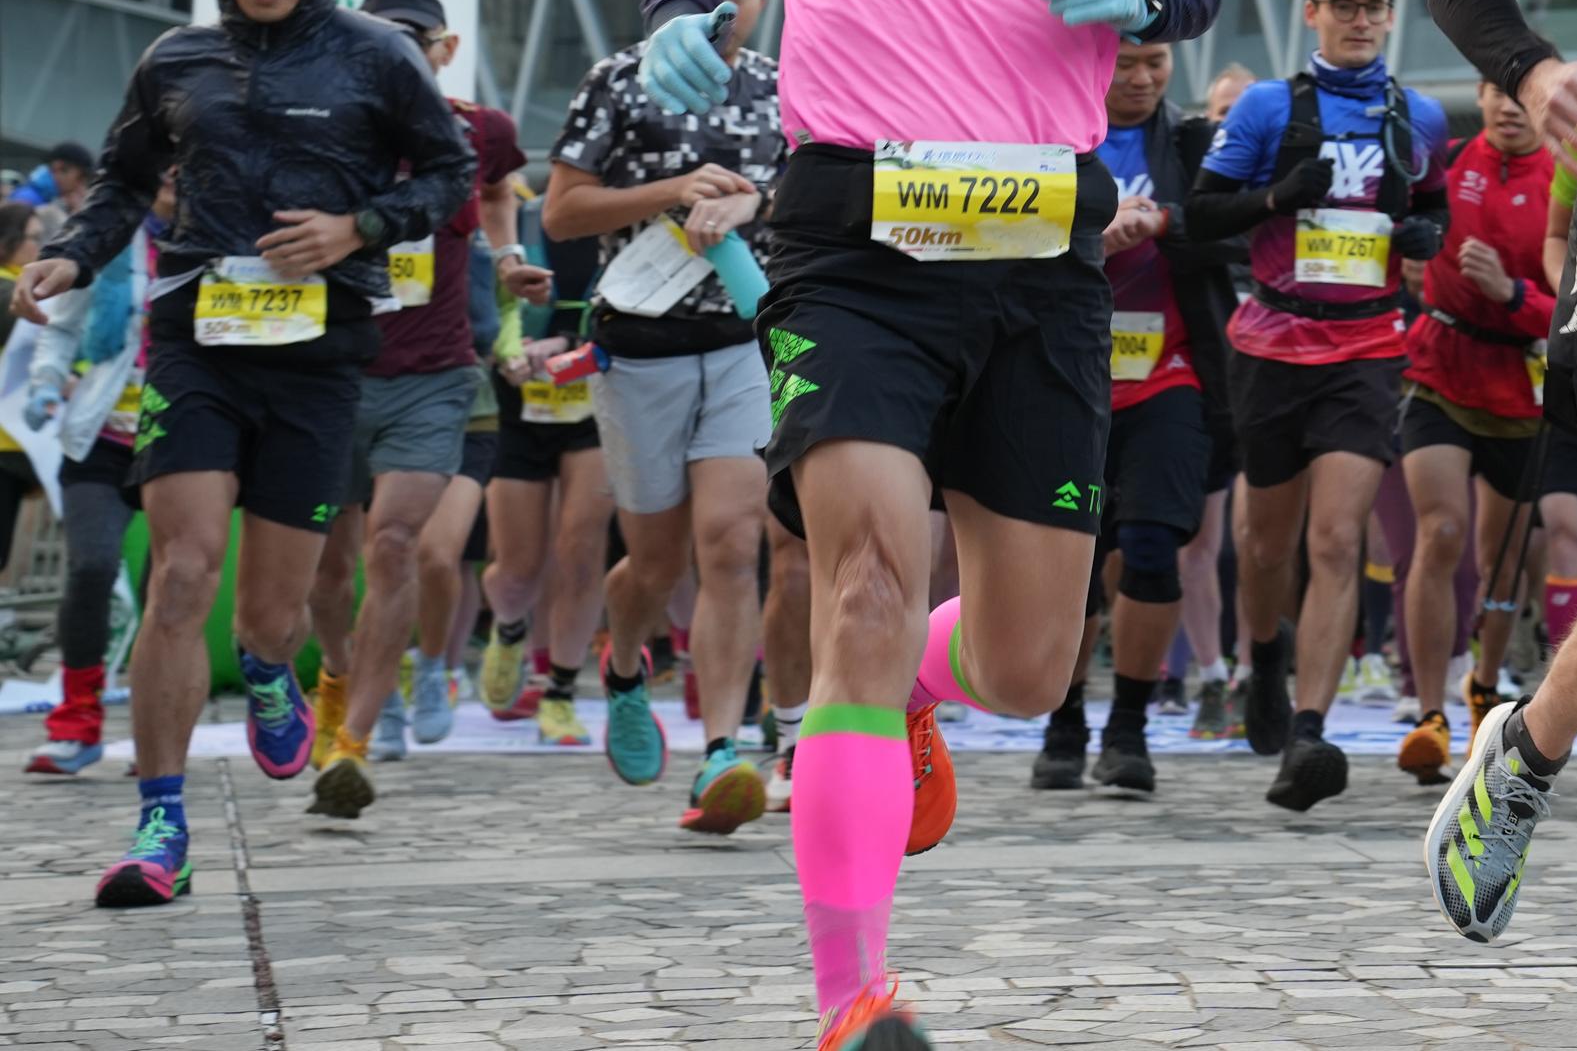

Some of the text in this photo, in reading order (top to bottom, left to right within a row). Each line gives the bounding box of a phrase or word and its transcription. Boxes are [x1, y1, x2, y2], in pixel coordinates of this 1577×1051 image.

[897, 176, 1041, 215] WM 7222
[888, 225, 963, 246] 50km
[1306, 235, 1377, 258] WM 7267
[391, 257, 416, 279] 50
[248, 288, 304, 312] 7237
